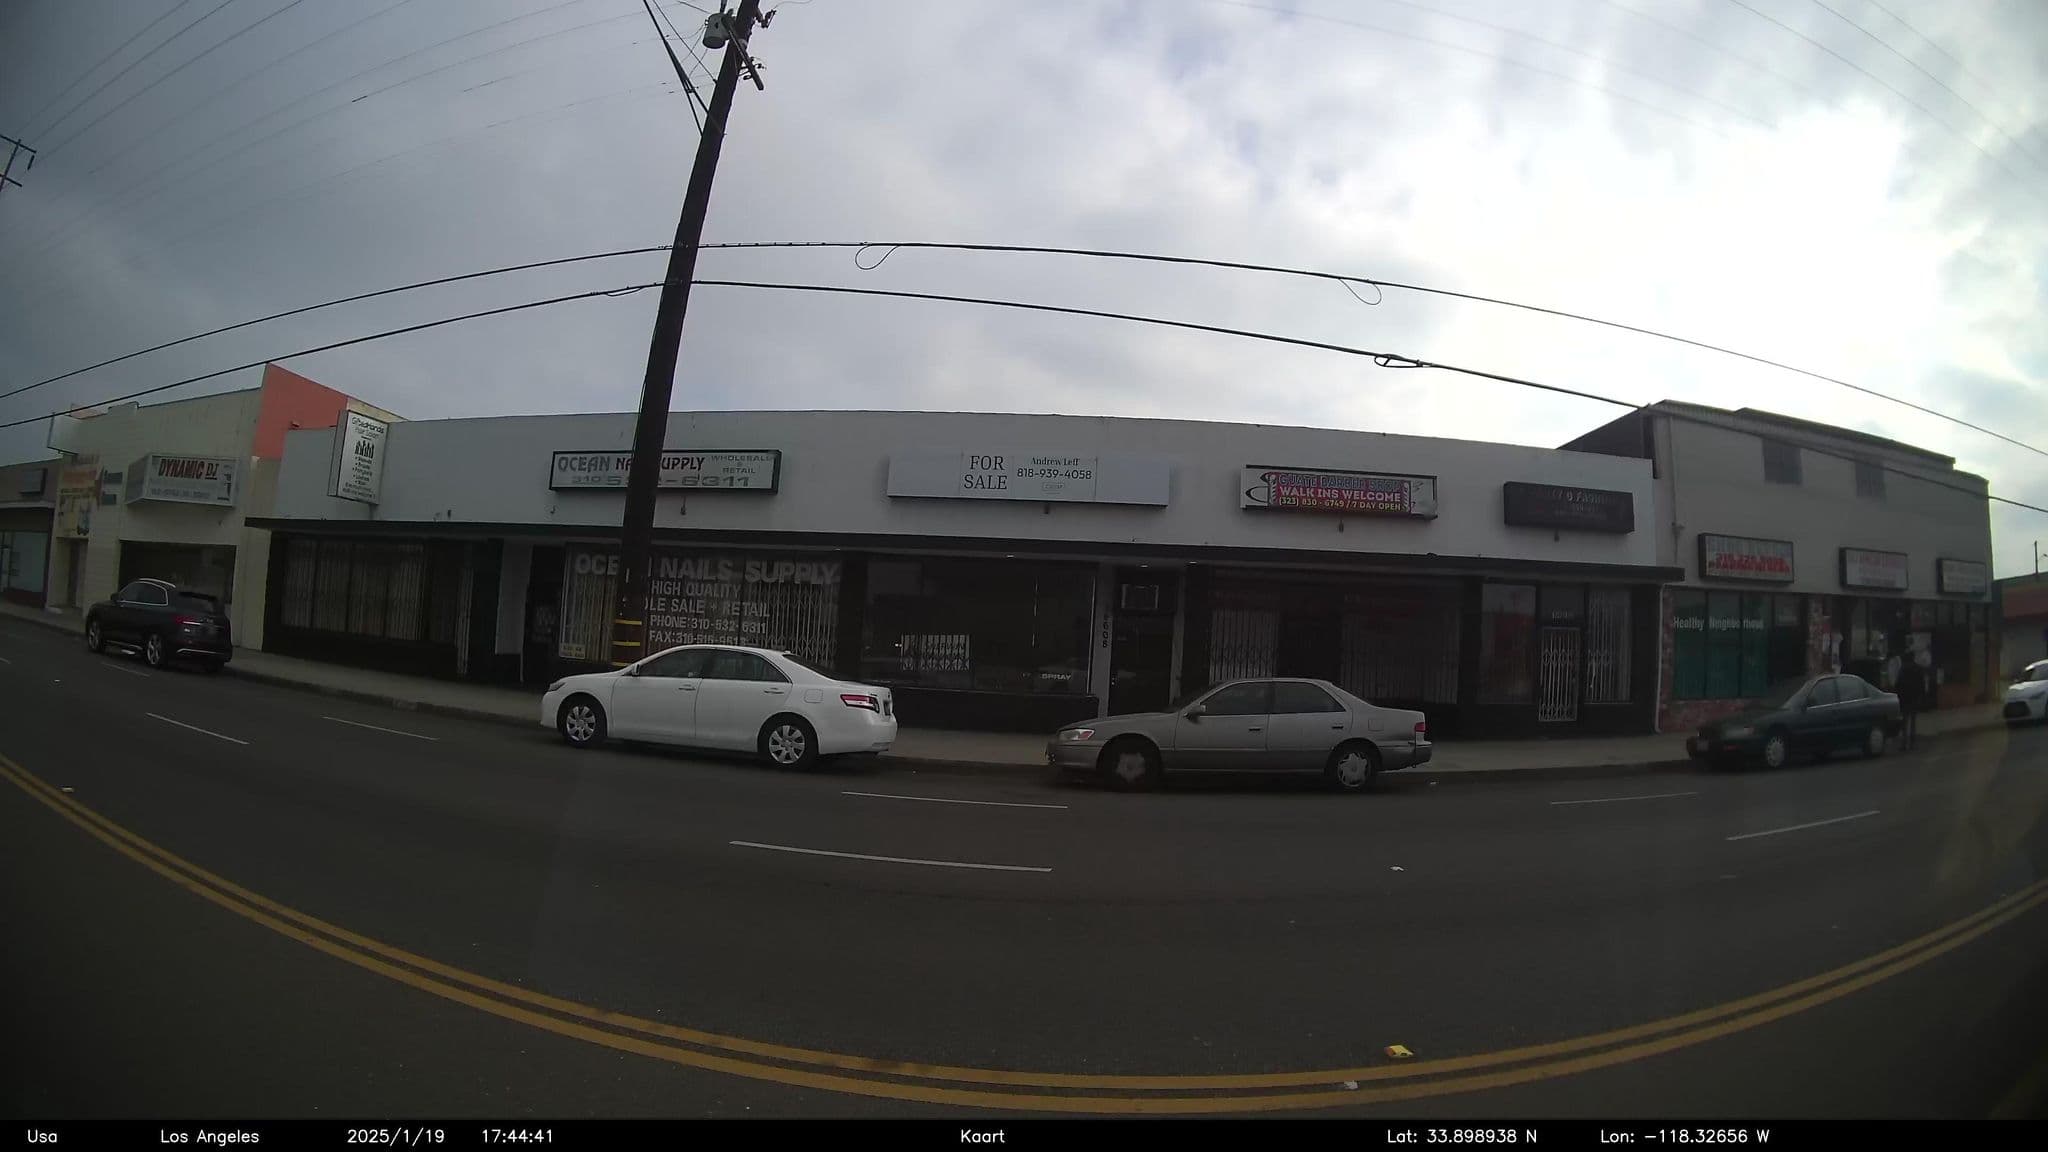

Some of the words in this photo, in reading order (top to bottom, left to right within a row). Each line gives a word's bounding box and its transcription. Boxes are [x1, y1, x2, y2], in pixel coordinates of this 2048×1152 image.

[158, 458, 205, 480] DYNAMIC
[557, 456, 610, 472] OCEAN
[660, 456, 704, 471] UPPLY
[970, 455, 1006, 471] FOR
[1031, 456, 1061, 466] Andrew
[1063, 457, 1080, 466] Leff
[722, 466, 756, 474] RETAIL
[1016, 468, 1092, 480] 818-939-4058
[964, 474, 1008, 490] SALE
[1280, 486, 1314, 498] WALK
[1318, 488, 1339, 499] INS
[1342, 489, 1401, 502] WELCOME
[1279, 496, 1299, 507] (323)
[1359, 501, 1376, 509] DAY
[1378, 502, 1401, 511] OPEN
[660, 556, 738, 580] NAILS
[744, 560, 843, 585] SUPPLY
[651, 579, 681, 595] HIGH
[686, 582, 742, 598] QUALITY
[671, 598, 706, 614] SALE
[722, 601, 771, 617] RETAIL
[1673, 616, 1705, 631] Healthy
